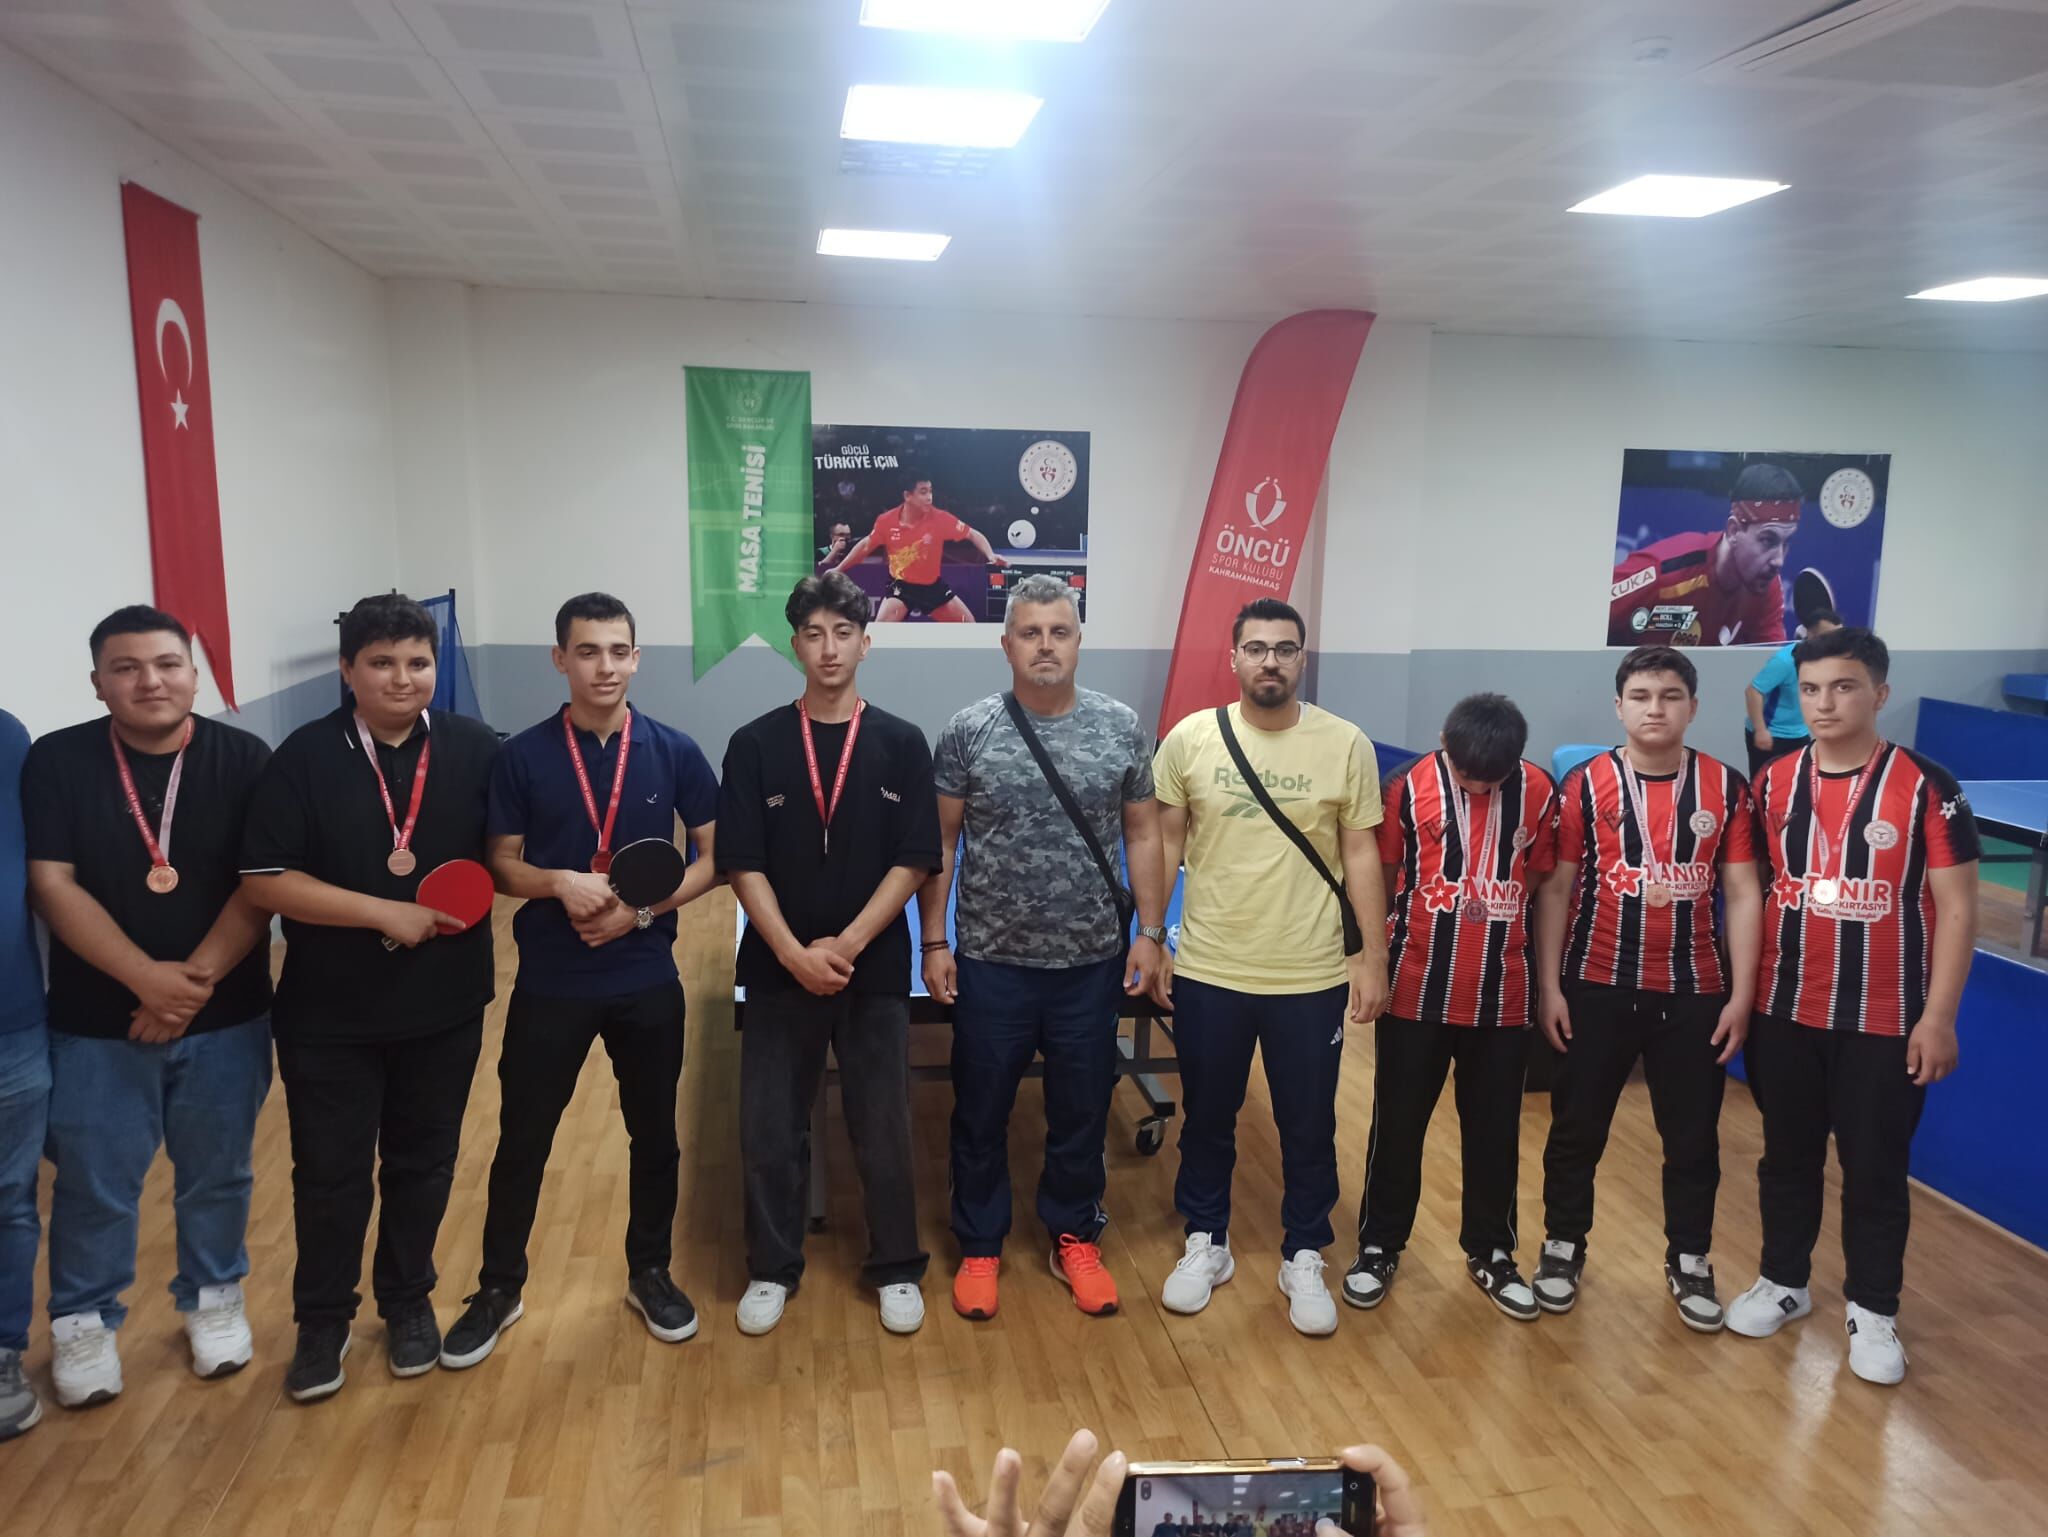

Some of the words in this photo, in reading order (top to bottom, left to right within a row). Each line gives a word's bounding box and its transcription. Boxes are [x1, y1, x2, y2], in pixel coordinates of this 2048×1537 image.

[814, 453, 872, 470] TÜRKİYE
[873, 455, 899, 471] İÇİN
[841, 444, 870, 456] GÜÇLÜ
[740, 445, 766, 520] TENİSİ
[1216, 523, 1290, 567] ÖNCÜ
[738, 525, 761, 593] MASA
[1211, 552, 1239, 568] SPOR
[1208, 565, 1281, 591] KAHRAMANMARAŞ
[1214, 766, 1313, 793] Rebok
[1806, 876, 1890, 902] TNIR
